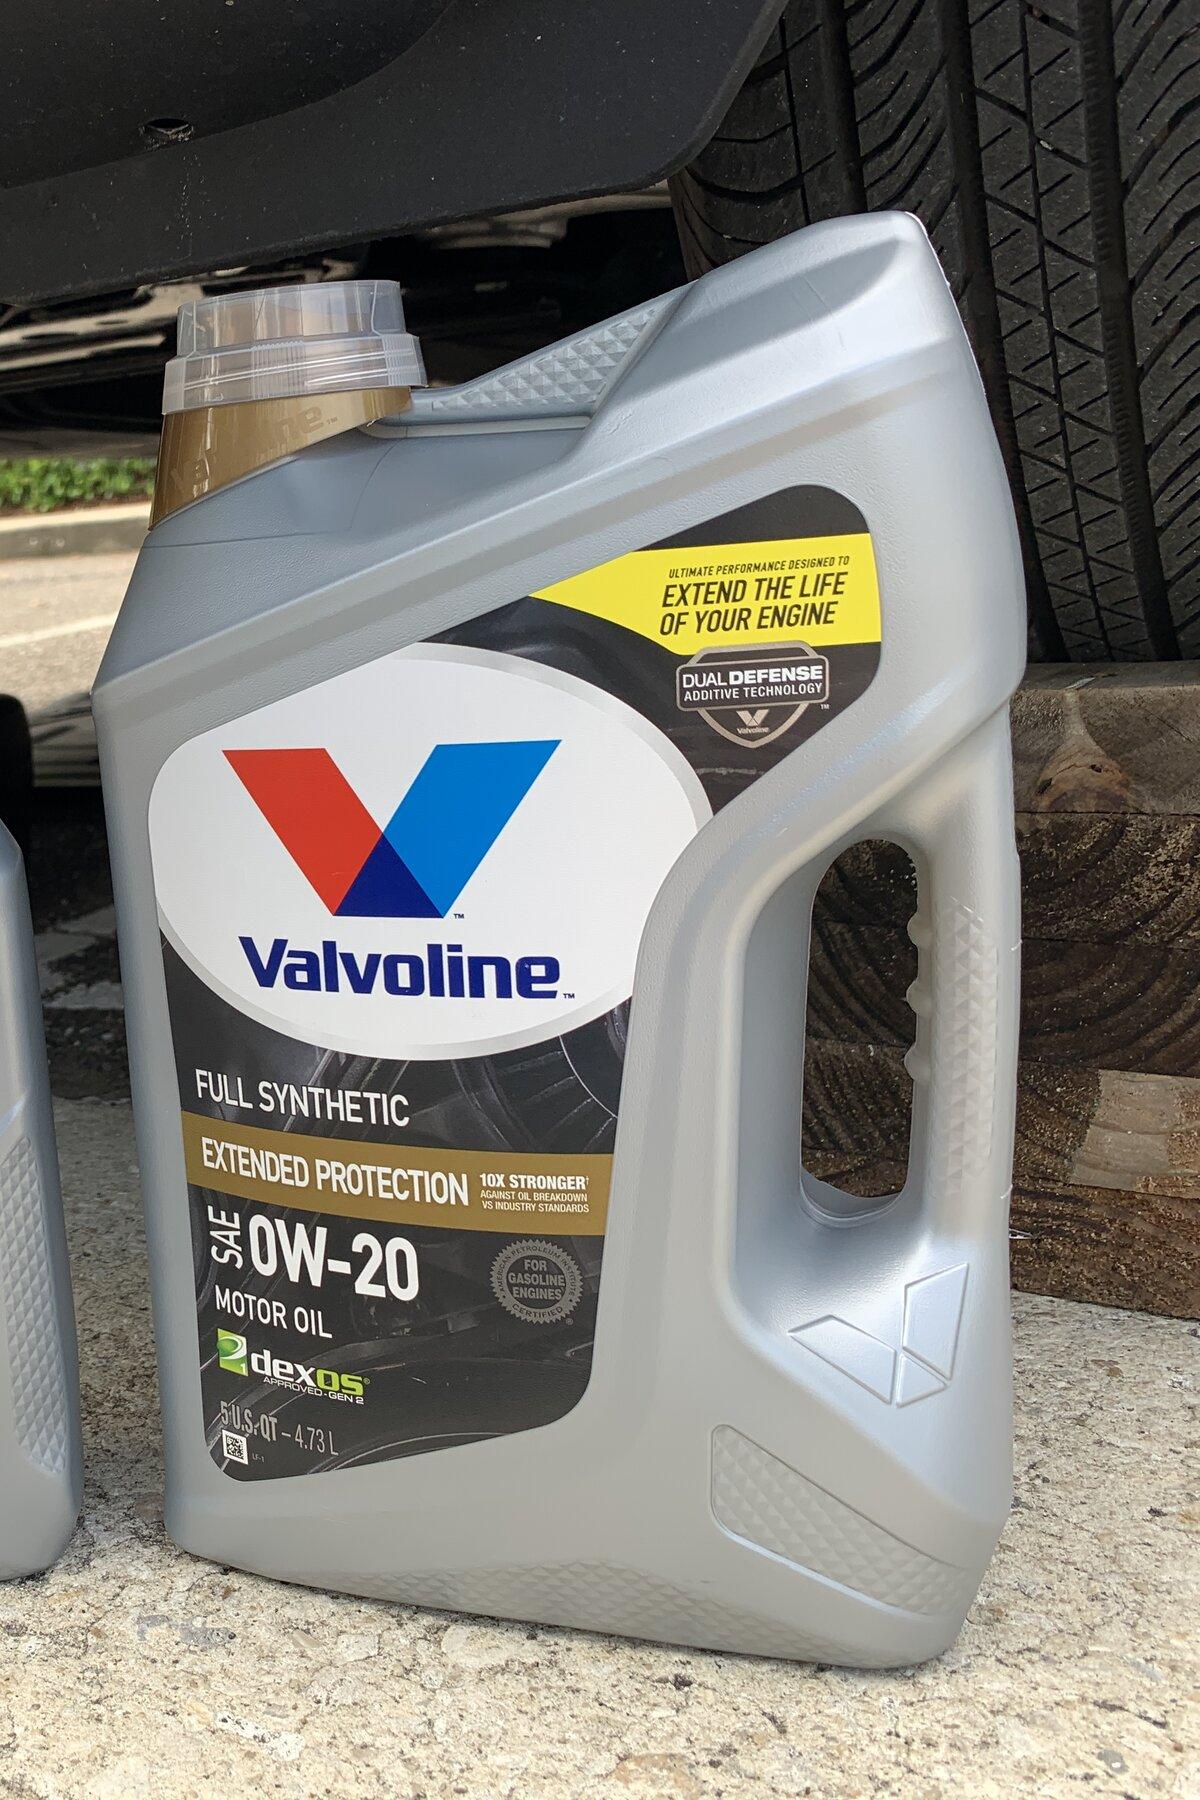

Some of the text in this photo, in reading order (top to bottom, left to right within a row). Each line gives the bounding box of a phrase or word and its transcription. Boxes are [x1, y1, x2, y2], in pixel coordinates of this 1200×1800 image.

[668, 556, 850, 578] ULTIMATE PERFORMANCE DESIGNED TO
[662, 572, 849, 607] EXTEND THE LIFE
[660, 601, 839, 635] OF YOUR ENGINE
[684, 682, 822, 701] ADDITIVE TECHNOLOGY
[238, 936, 560, 999] Valvoline
[195, 1069, 409, 1127] FULL SYNTHETIC
[201, 1136, 469, 1206] EXTENDED PROTECTION
[480, 1173, 505, 1187] 10X
[480, 1190, 587, 1201] AGAINST OIL BREAKDOWN
[482, 1201, 589, 1212] VS INDUSTRY STANDARDS
[208, 1206, 242, 1269] SAE
[249, 1213, 419, 1301] 0W-20
[524, 1260, 547, 1271] FOR
[508, 1273, 565, 1286] GASOLINE
[513, 1287, 561, 1300] ENGINES
[215, 1284, 332, 1338] MOTOR OIL
[513, 1304, 562, 1317] CERTIFIED
[252, 1349, 364, 1396] dexos
[220, 1401, 229, 1425] 5
[260, 1414, 277, 1442] QT
[295, 1424, 325, 1453] 4.73
[329, 1431, 338, 1455] L
[252, 1453, 264, 1462] LF-1
